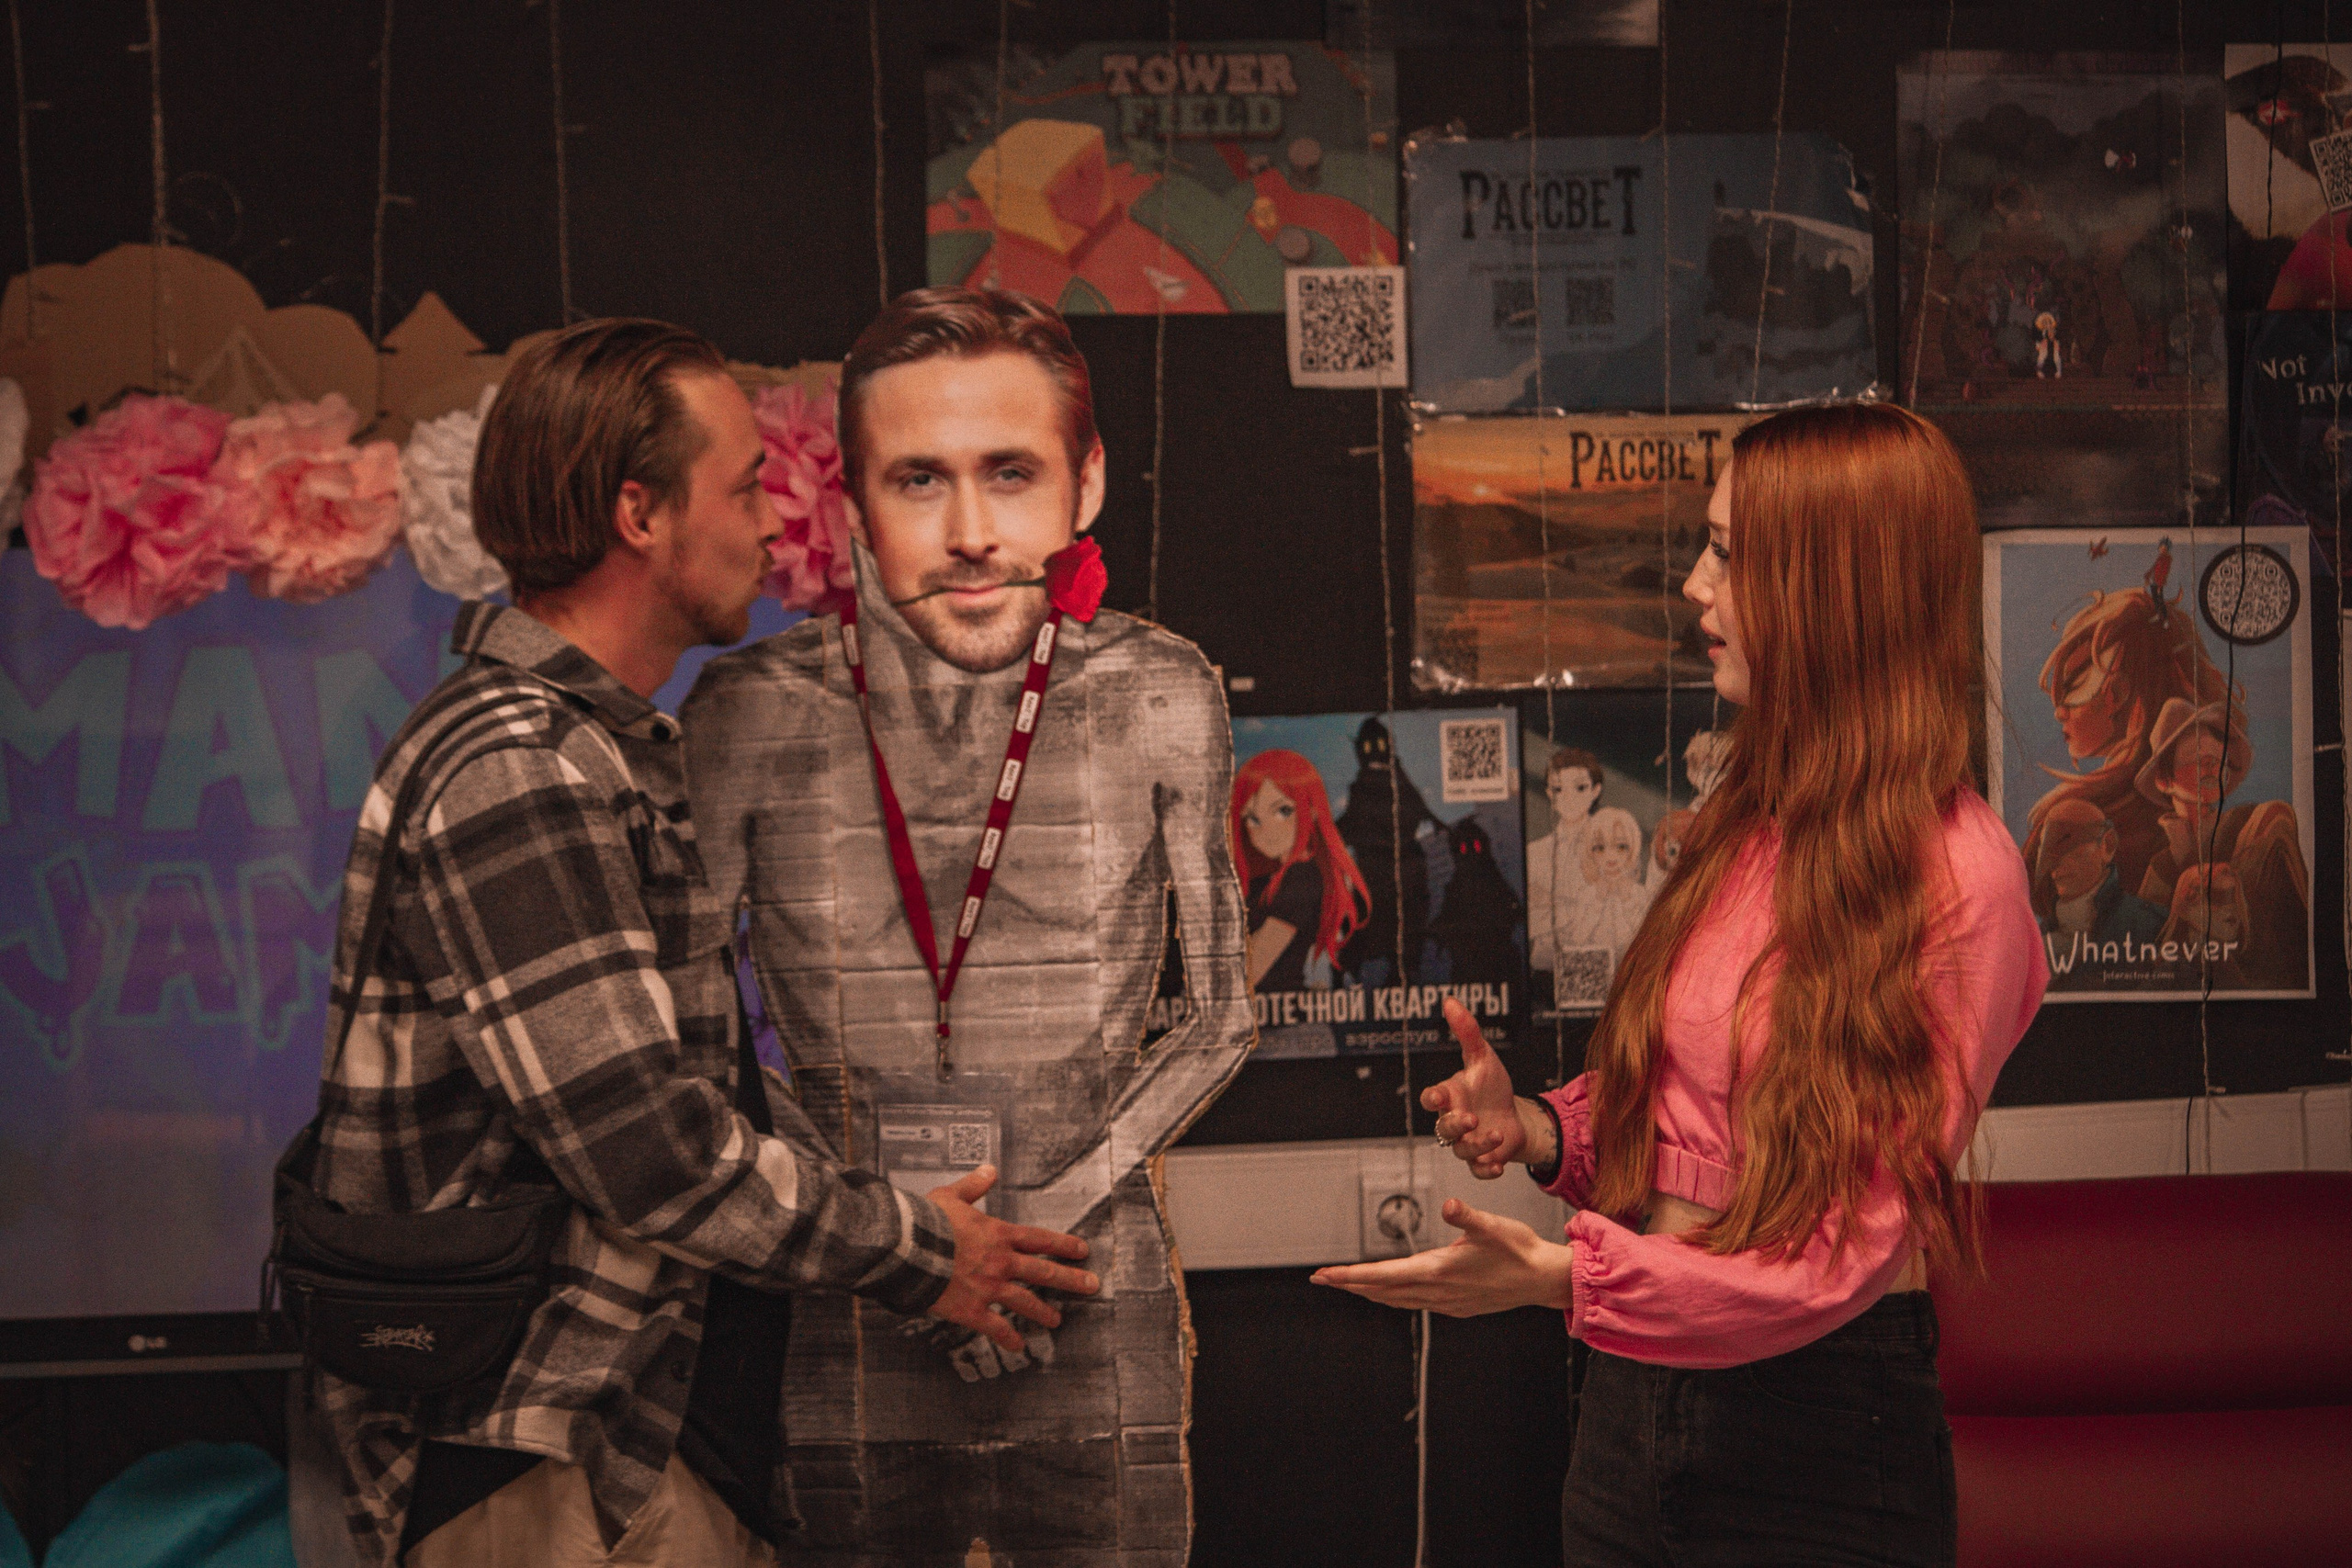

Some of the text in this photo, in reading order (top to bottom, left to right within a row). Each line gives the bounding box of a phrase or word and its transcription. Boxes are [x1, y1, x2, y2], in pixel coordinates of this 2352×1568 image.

[1102, 52, 1297, 96] TOWER
[1118, 95, 1283, 135] FIELD
[1460, 165, 1641, 239] РАССВЕТ
[1569, 422, 1721, 489] РАССВЕТ
[2046, 930, 2239, 975] Whatnever
[1255, 982, 1366, 1027] ОТЕЧНОЙ
